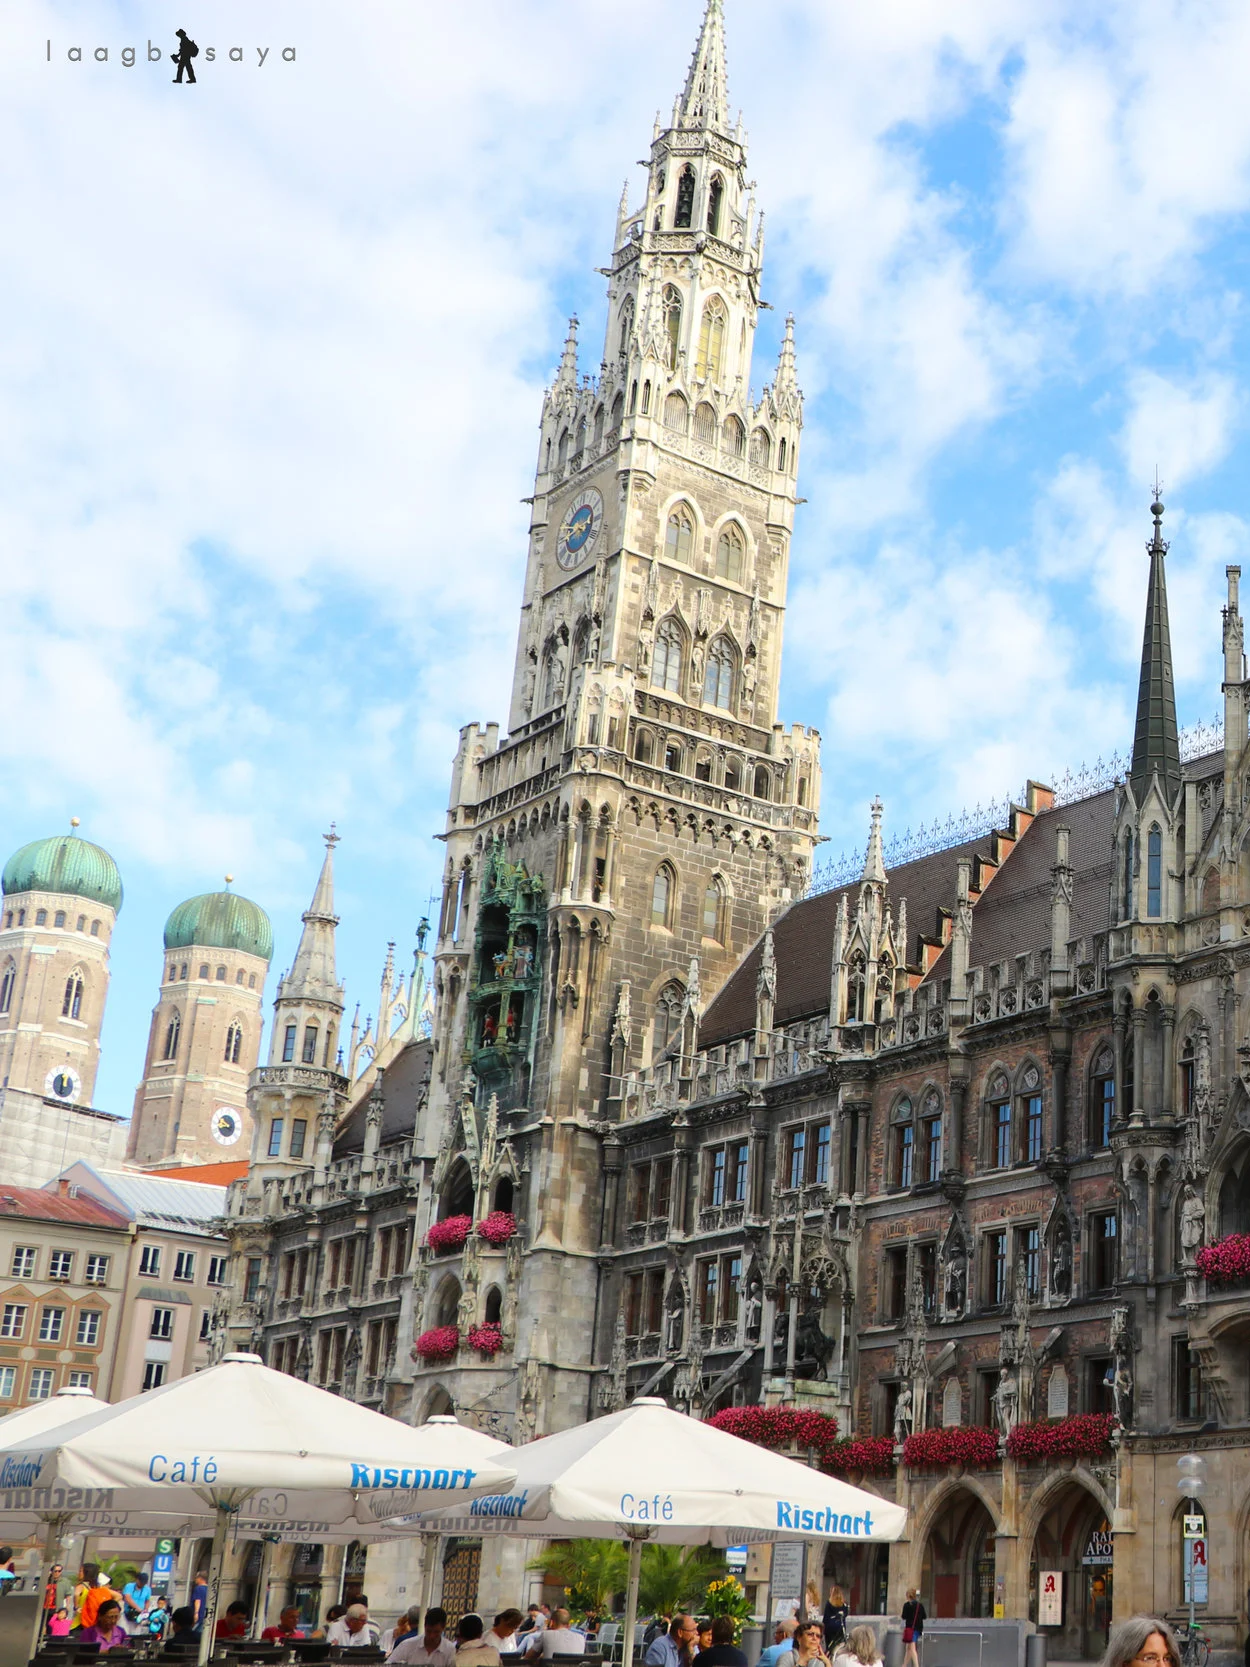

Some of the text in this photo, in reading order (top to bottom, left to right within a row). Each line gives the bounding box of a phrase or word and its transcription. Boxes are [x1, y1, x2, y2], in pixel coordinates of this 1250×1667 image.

[148, 1454, 219, 1484] Café
[620, 1493, 673, 1520] Café
[776, 1500, 875, 1536] Rischart
[159, 1539, 173, 1554] S
[1086, 1541, 1113, 1556] APO
[157, 1556, 169, 1571] U
